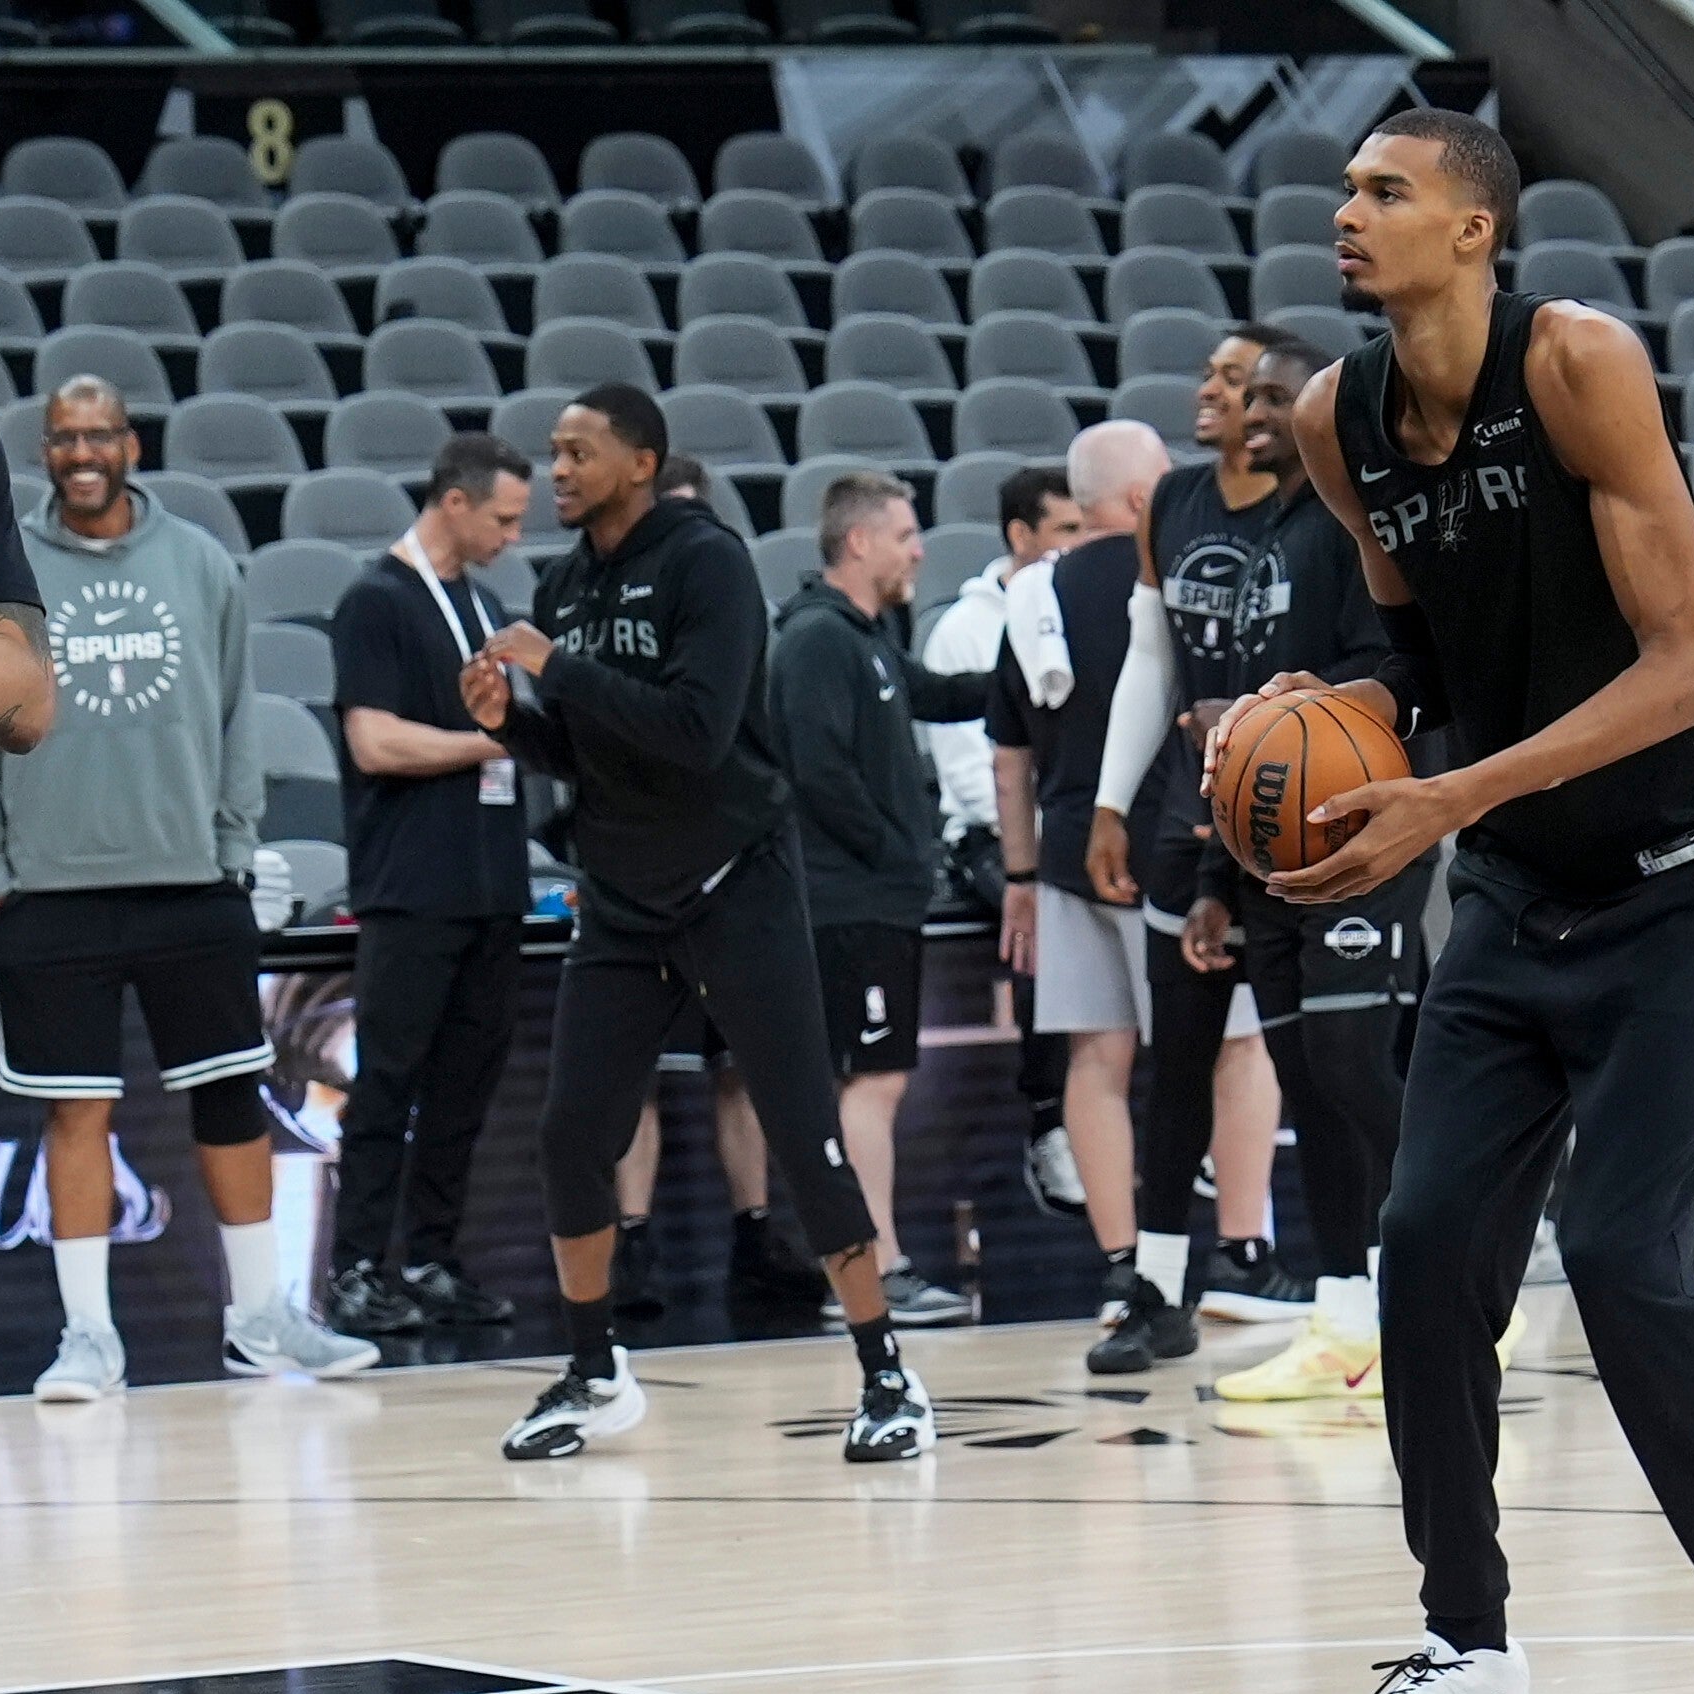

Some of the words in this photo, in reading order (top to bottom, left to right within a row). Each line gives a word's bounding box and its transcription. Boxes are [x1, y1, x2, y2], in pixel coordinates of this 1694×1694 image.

[247, 99, 294, 184] 8
[1483, 416, 1522, 438] LEDGER
[66, 631, 165, 664] SPURS
